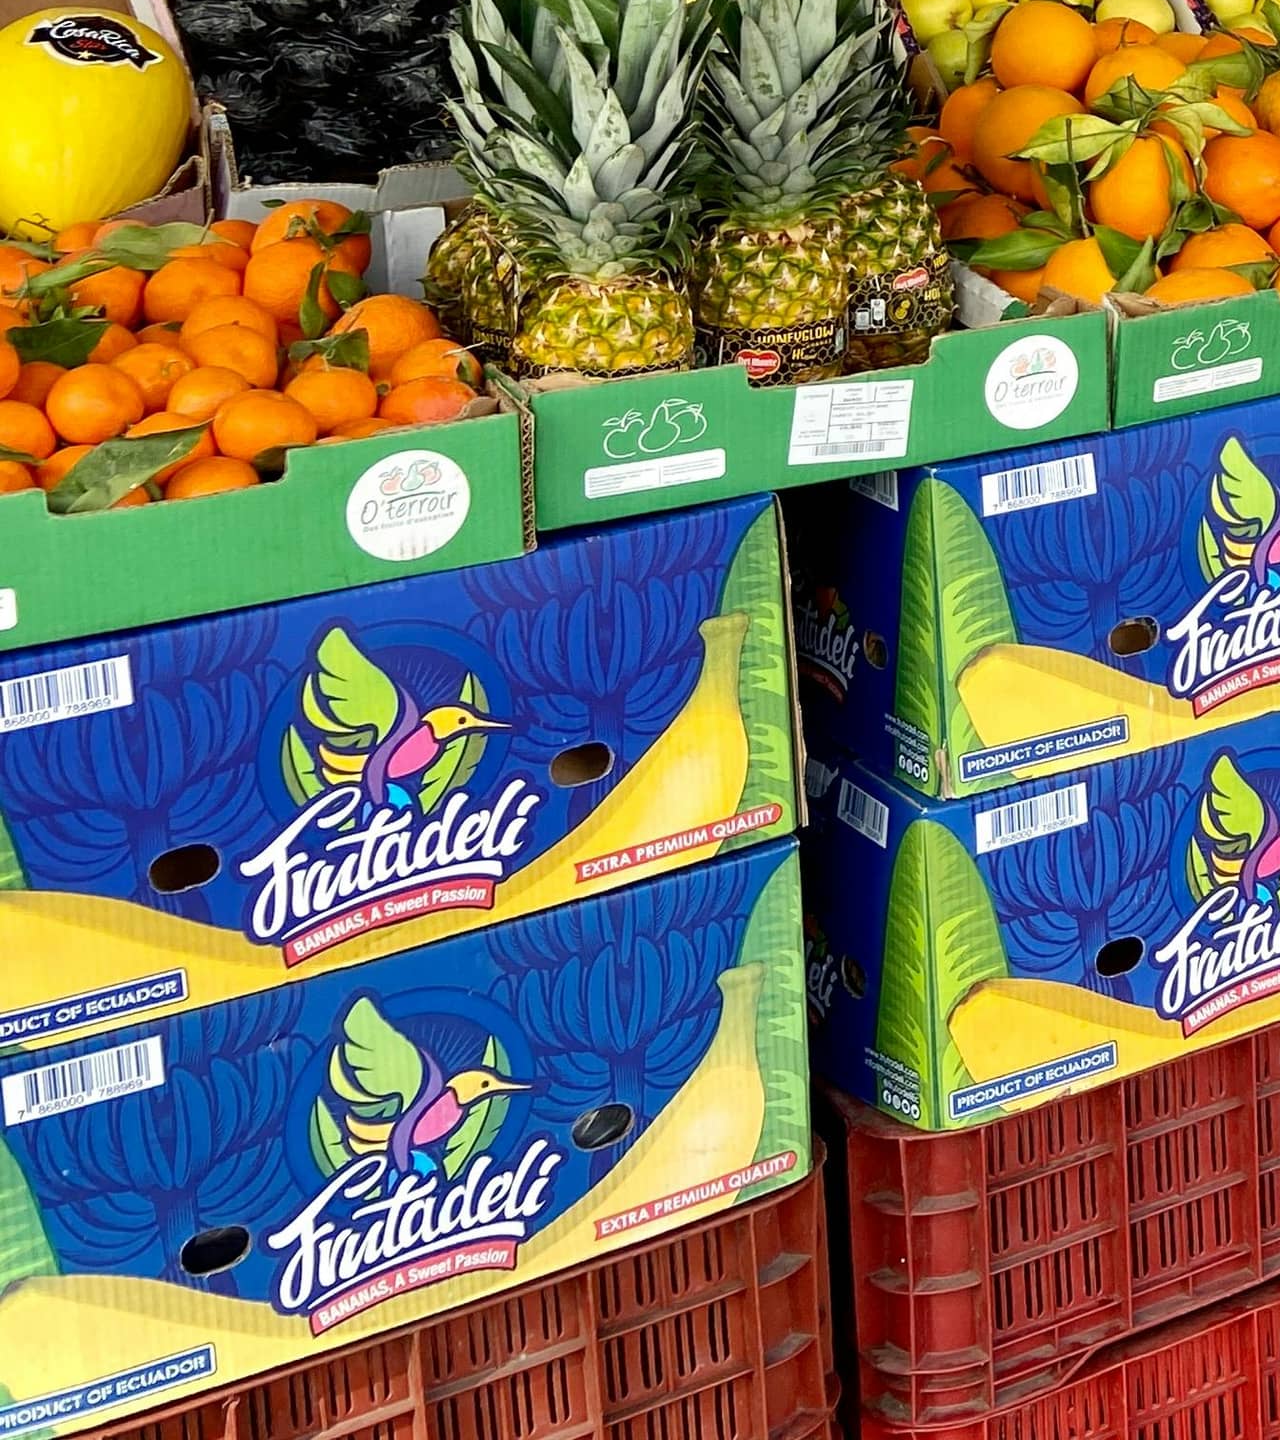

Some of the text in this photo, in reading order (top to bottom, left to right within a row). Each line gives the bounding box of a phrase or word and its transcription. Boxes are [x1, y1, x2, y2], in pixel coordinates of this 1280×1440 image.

[994, 376, 1067, 403] O'terroir
[361, 492, 457, 525] O'terroir
[1200, 675, 1249, 709] BANANAS,
[1252, 669, 1260, 681] A
[968, 724, 1121, 772] PRODUCT OF ECUADOR
[240, 780, 537, 939] Frutadeli
[581, 808, 775, 878] EXTRA PREMIUM QUALITY
[293, 887, 486, 954] BANANAS, A Sweet Passion
[55, 1007, 82, 1021] OF
[86, 980, 178, 1016] ECUADOR
[1189, 994, 1239, 1026] BANANAS,
[1241, 987, 1250, 1000] A
[956, 1050, 1111, 1109] PRODUCT OF ECUADOR
[600, 1154, 792, 1235] EXTRA PREMIUM QUALITY
[269, 1140, 561, 1310] Frutadeli
[319, 1250, 508, 1326] BANANAS, A Sweet Passion
[86, 1385, 112, 1404] OF
[116, 1353, 206, 1393] ECUADOR
